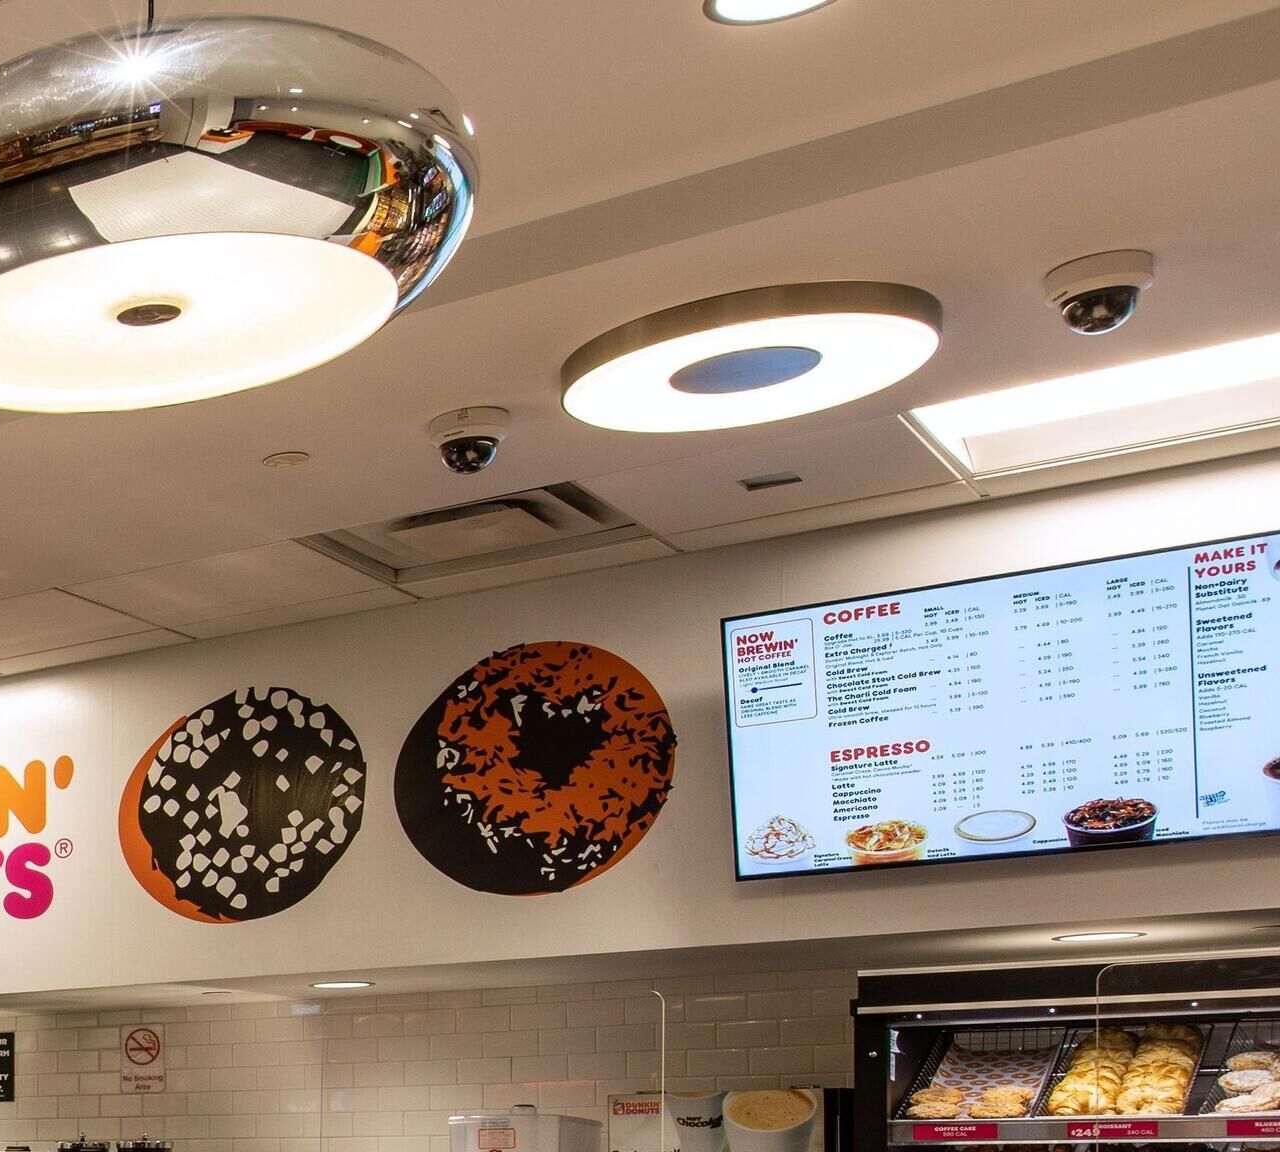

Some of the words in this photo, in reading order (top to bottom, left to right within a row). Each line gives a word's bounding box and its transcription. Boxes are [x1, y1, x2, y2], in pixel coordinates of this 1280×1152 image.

[1194, 547, 1245, 564] MAKE
[1250, 543, 1268, 555] IT
[1194, 560, 1257, 578] YOURS
[1106, 577, 1128, 585] LARGE
[1195, 586, 1249, 599] Substitute
[823, 602, 901, 625] COFFEE
[1196, 613, 1253, 626] Sweetened
[1196, 623, 1234, 633] Flavors
[736, 631, 774, 646] NOW
[824, 632, 853, 642] Coffee
[737, 639, 798, 657] BREWIN'
[824, 649, 848, 659] Extra
[850, 644, 888, 655] Charged
[738, 656, 756, 664] HOT
[758, 651, 792, 661] COFFEE
[738, 663, 771, 674] Original
[772, 660, 795, 668] Blend
[826, 669, 846, 677] Cold
[848, 666, 868, 674] Brew
[1198, 665, 1267, 679] Unsweetened
[826, 678, 870, 690] Chocolate
[872, 674, 896, 683] Stout
[897, 671, 917, 679] Cold
[918, 668, 941, 677] Brew
[1198, 677, 1236, 687] Flavors
[740, 696, 764, 705] Decaf
[827, 694, 843, 703] The
[844, 690, 871, 701] Charli
[872, 688, 891, 697] Cold
[893, 685, 917, 694] Foam
[828, 706, 848, 715] Cold
[850, 704, 870, 713] Brew
[828, 718, 858, 728] Frozen
[860, 714, 889, 724] Coffee
[830, 740, 930, 763] ESPRESSO
[831, 762, 872, 772] Signature
[874, 758, 899, 767] Latte
[832, 782, 855, 790] Latte
[832, 788, 882, 799] Cappuccino
[833, 796, 877, 806] Macchiato
[833, 804, 878, 814] Americano
[834, 813, 870, 823] Espresso
[134, 1074, 163, 1084] Smoking
[135, 1083, 151, 1091] Area
[624, 1101, 662, 1109] DUNKIN'
